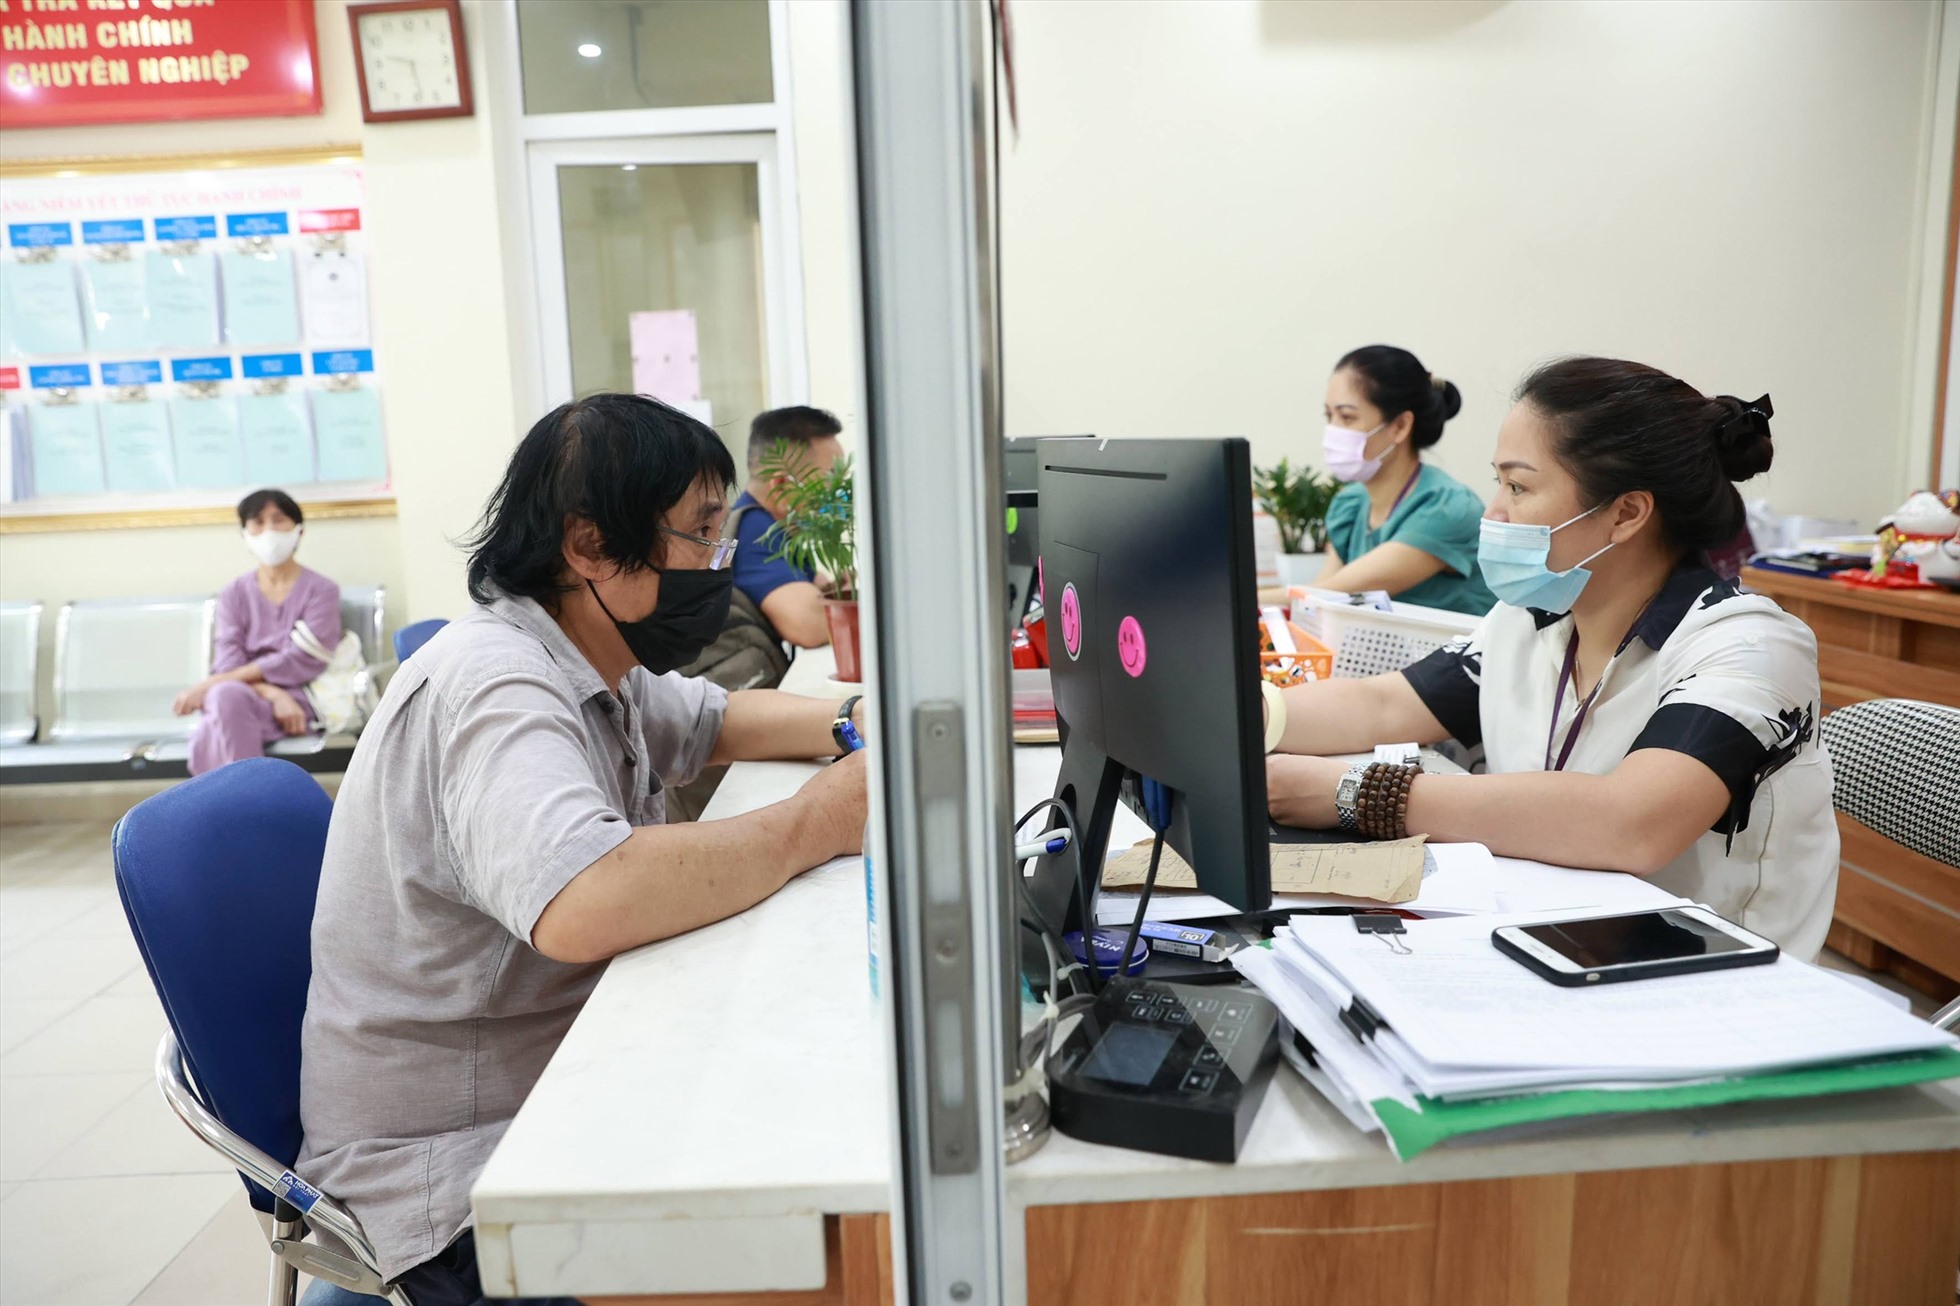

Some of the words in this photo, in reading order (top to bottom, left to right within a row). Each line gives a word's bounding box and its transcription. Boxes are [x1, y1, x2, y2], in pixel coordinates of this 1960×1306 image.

[2, 18, 88, 50] HÀNH
[96, 14, 194, 48] CHÍNH
[7, 55, 130, 88] CHUYÊN
[138, 49, 250, 86] NGHIỆP
